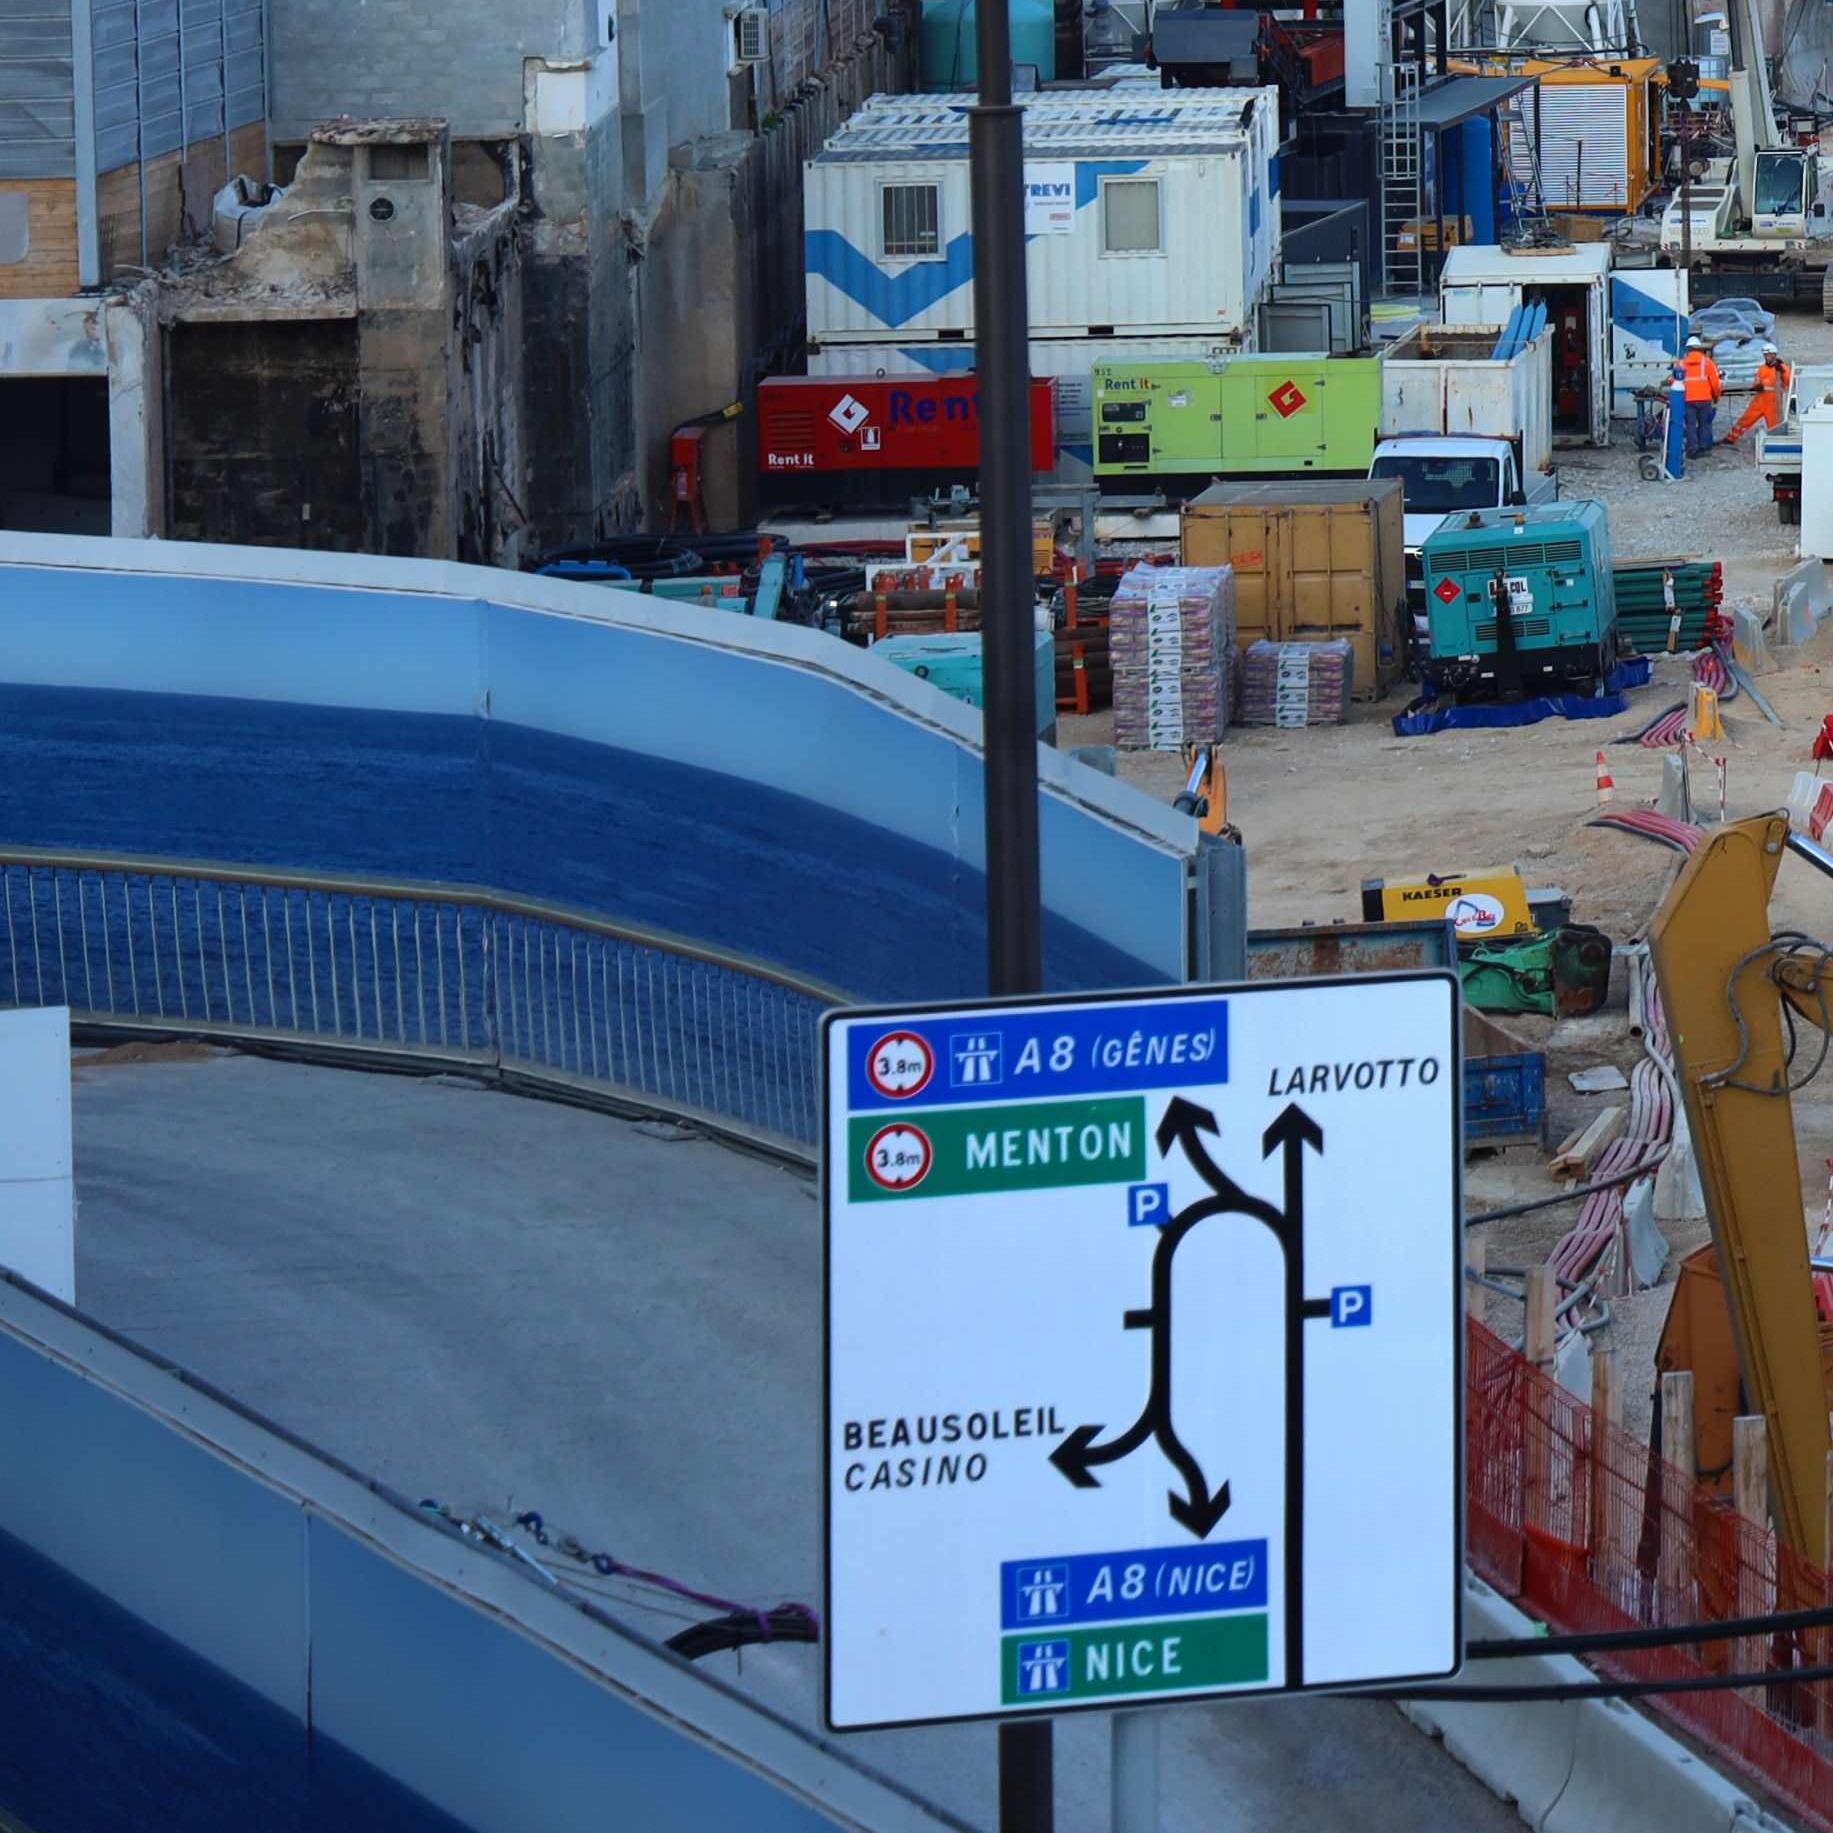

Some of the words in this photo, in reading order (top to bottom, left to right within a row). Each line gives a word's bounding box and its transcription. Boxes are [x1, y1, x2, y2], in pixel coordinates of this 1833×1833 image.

[1105, 379, 1136, 390] Rent
[1140, 378, 1150, 390] it
[768, 453, 801, 465] Rent
[803, 453, 815, 465] it
[1402, 887, 1462, 901] KAESER
[1013, 1034, 1075, 1074] A8
[1090, 1029, 1215, 1069] (GÊNES)
[1267, 1056, 1440, 1098] LARVOTTO
[966, 1121, 1133, 1170] MENTON
[1136, 1189, 1161, 1220] P
[1338, 1292, 1364, 1322] P
[843, 1407, 1065, 1451] BEAUSOLEIL
[844, 1453, 988, 1492] CASINO
[1085, 1564, 1145, 1604] A8
[1155, 1556, 1256, 1597] (NICE)
[1086, 1636, 1183, 1682] NICE
